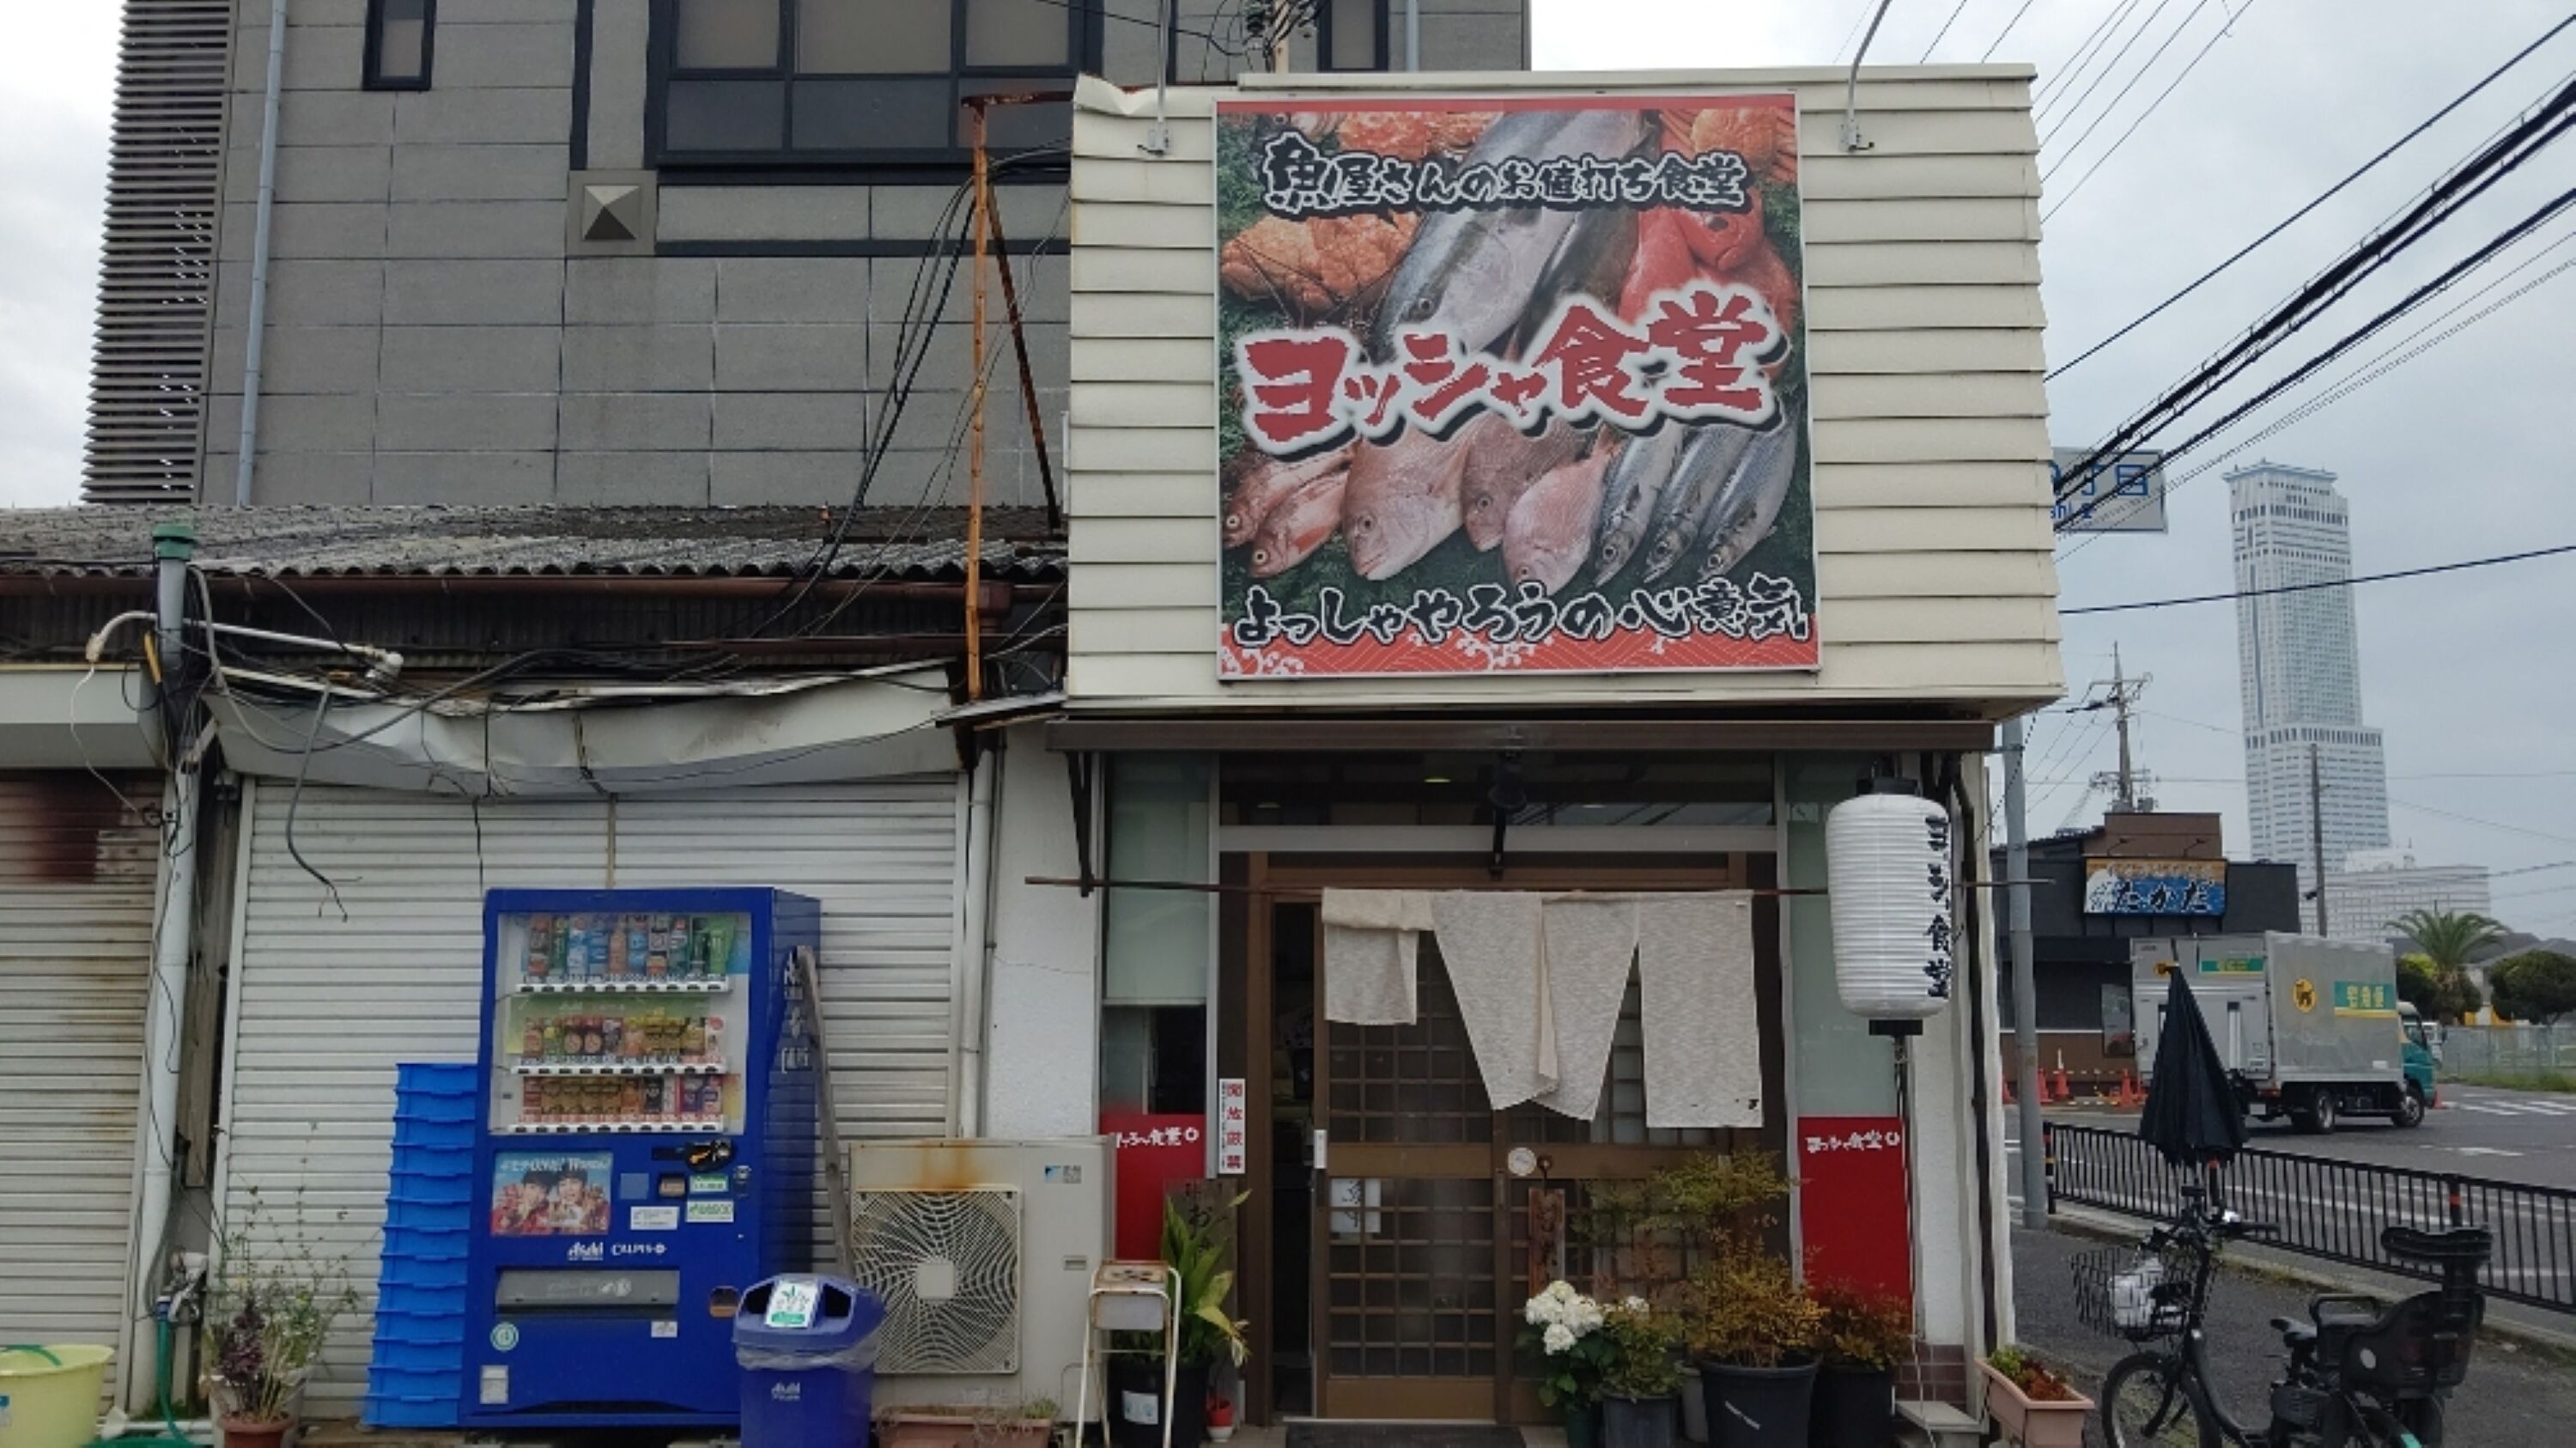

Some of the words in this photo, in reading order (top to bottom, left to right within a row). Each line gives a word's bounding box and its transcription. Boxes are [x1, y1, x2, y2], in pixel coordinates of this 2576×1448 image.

[1262, 131, 1749, 211] 魚屋さんのお値打ち食堂
[1242, 285, 1774, 447] ヨッシャ食堂
[1235, 572, 1808, 645] よっしゃやろうの心意気
[2347, 985, 2384, 1008] 宅急便
